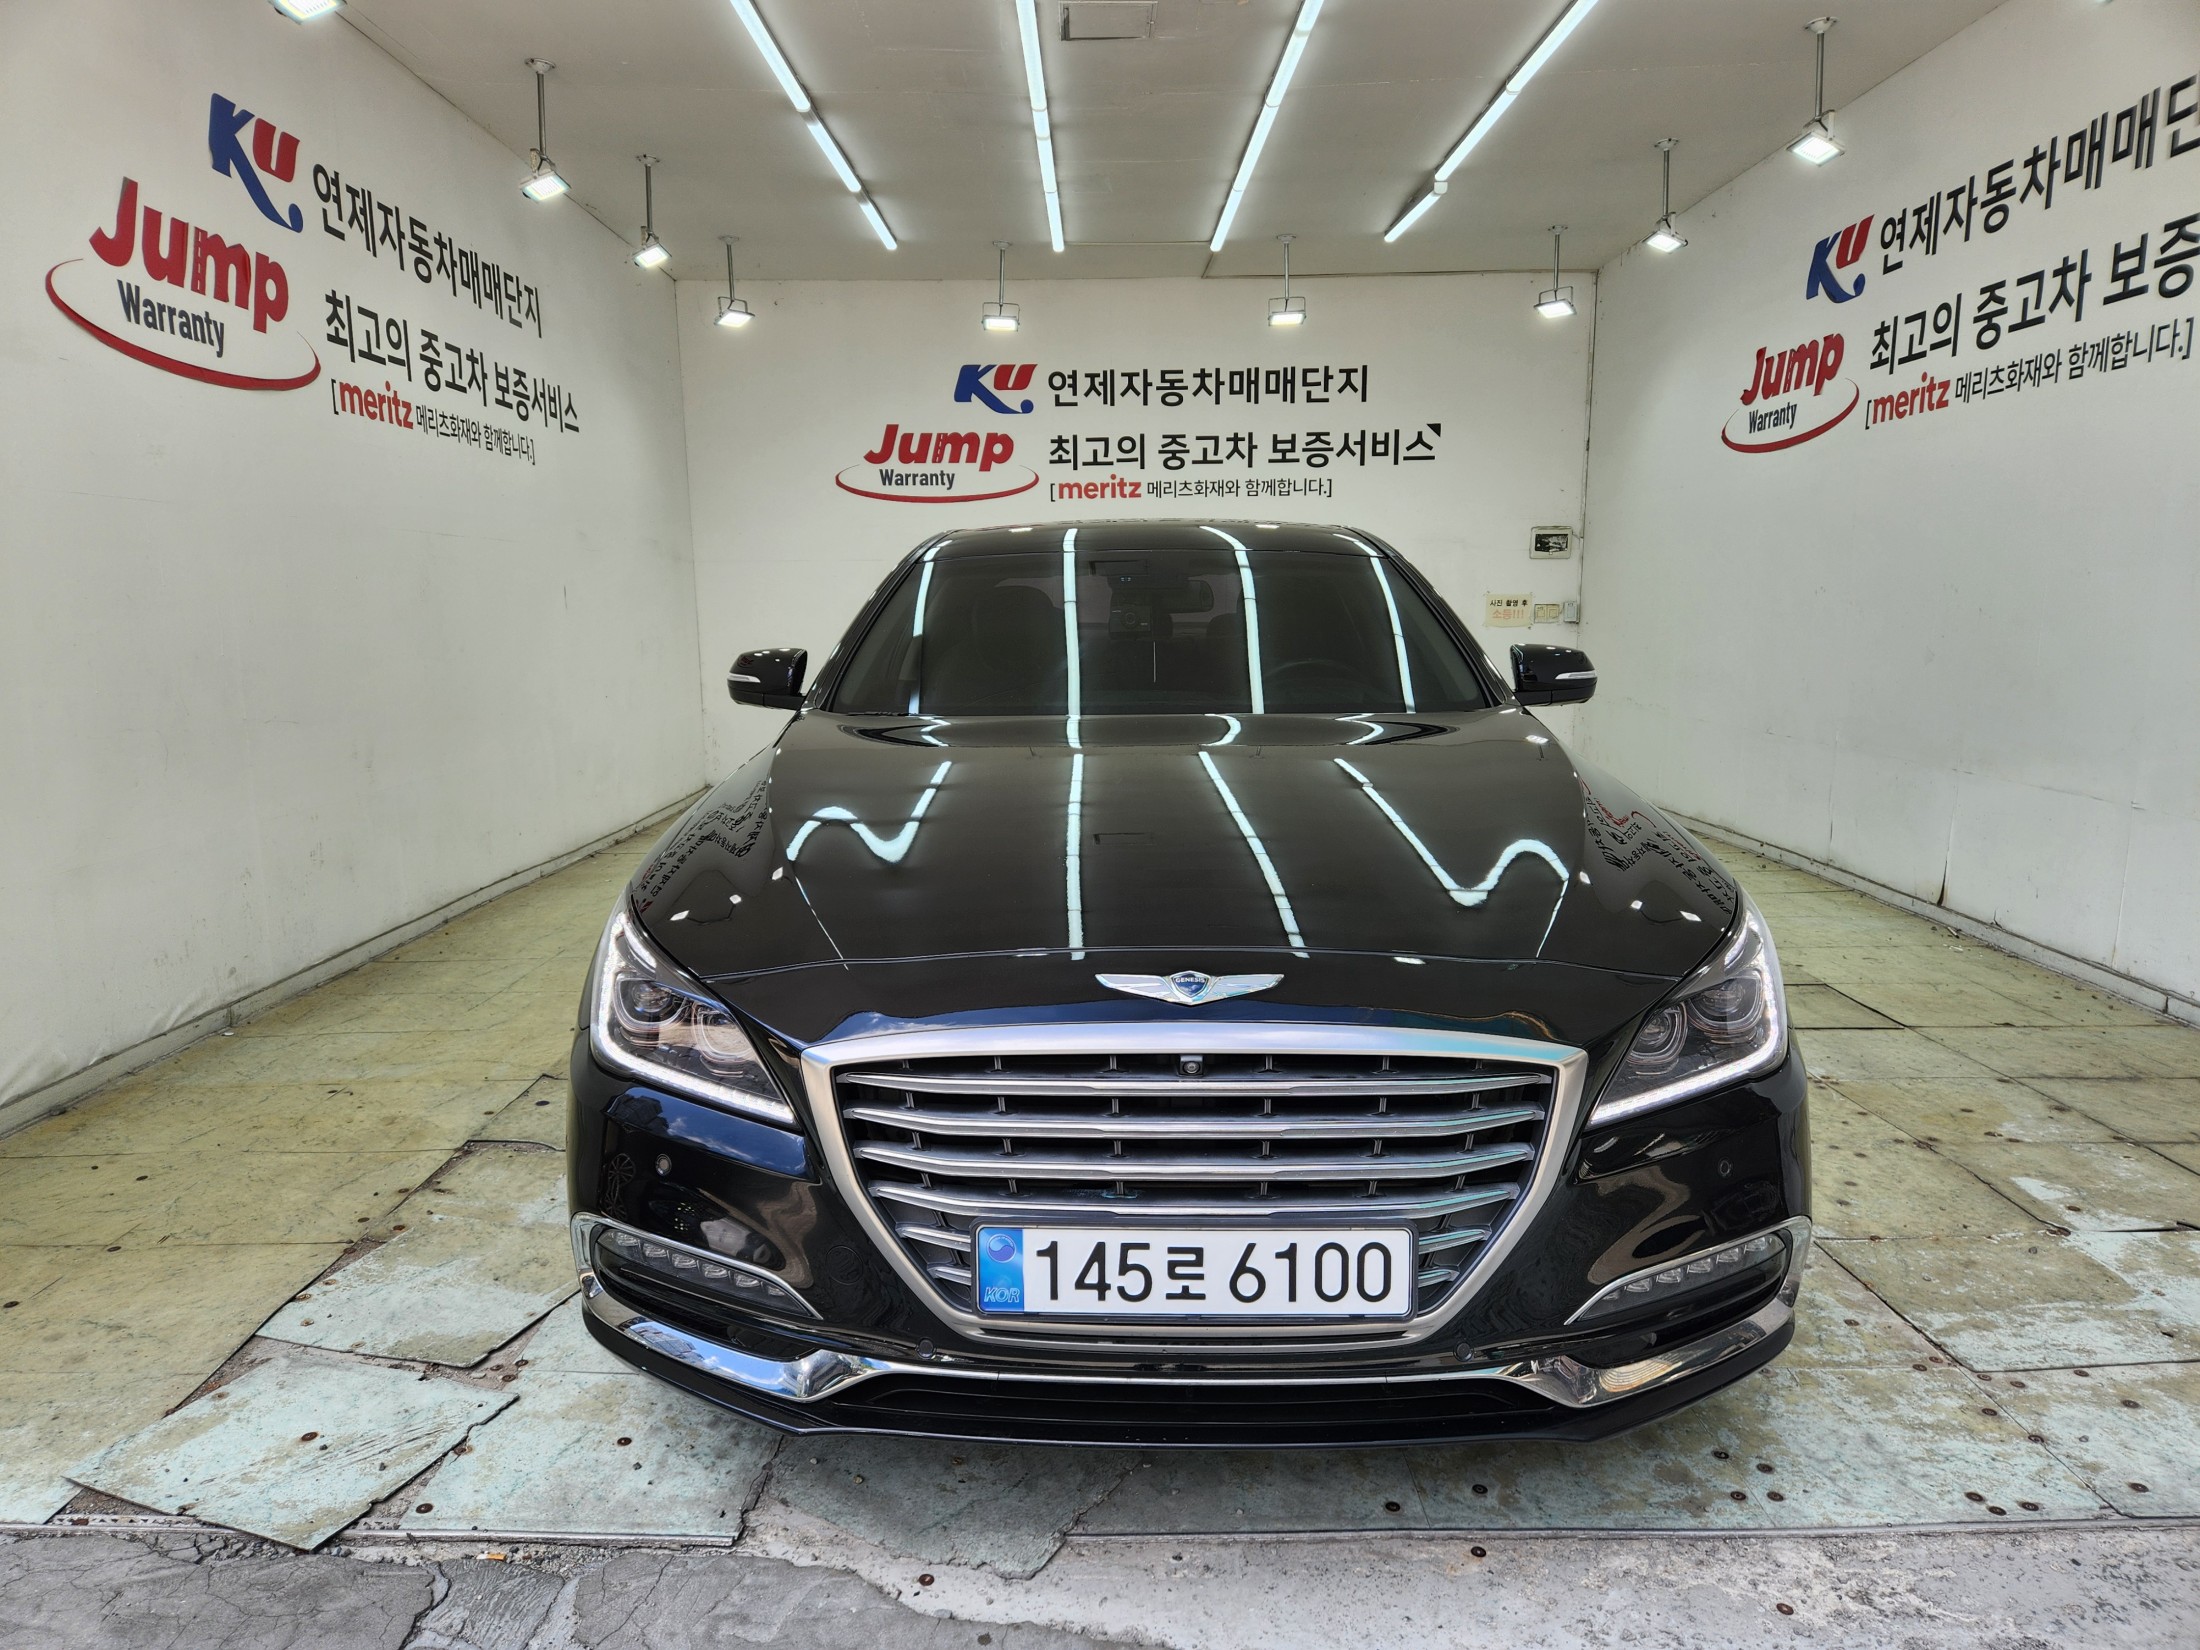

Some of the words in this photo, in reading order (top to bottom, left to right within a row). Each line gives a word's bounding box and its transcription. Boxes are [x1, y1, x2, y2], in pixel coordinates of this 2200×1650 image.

[89, 176, 289, 333] Jump
[312, 163, 542, 338] 연제자동차매매단지
[1870, 293, 1962, 375] 최고의
[1973, 248, 2092, 350] 중고차
[2102, 212, 2200, 306] 보증
[117, 279, 225, 358] Warranty
[325, 289, 412, 382] 최고의
[419, 328, 488, 407] 중고차
[494, 361, 579, 433] 보증서비스
[1740, 333, 1845, 405] Jump
[1955, 348, 2062, 404] 메리츠화재와
[1048, 365, 1368, 407] 연제자동차매매단지
[416, 405, 481, 449] 메리츠화재와
[1748, 401, 1798, 435] Warranty
[863, 424, 1014, 472] Jump
[1049, 433, 1145, 471] 최고의
[1158, 432, 1258, 470] 중고차
[1267, 429, 1436, 468] 보증서비스
[879, 468, 955, 491] Warranty
[1147, 479, 1241, 499] 메리츠화재와
[1490, 599, 1503, 607] 사진
[983, 1286, 1020, 1303] KOR
[1036, 1240, 1207, 1302] 145로
[1228, 1241, 1393, 1303] 6100
